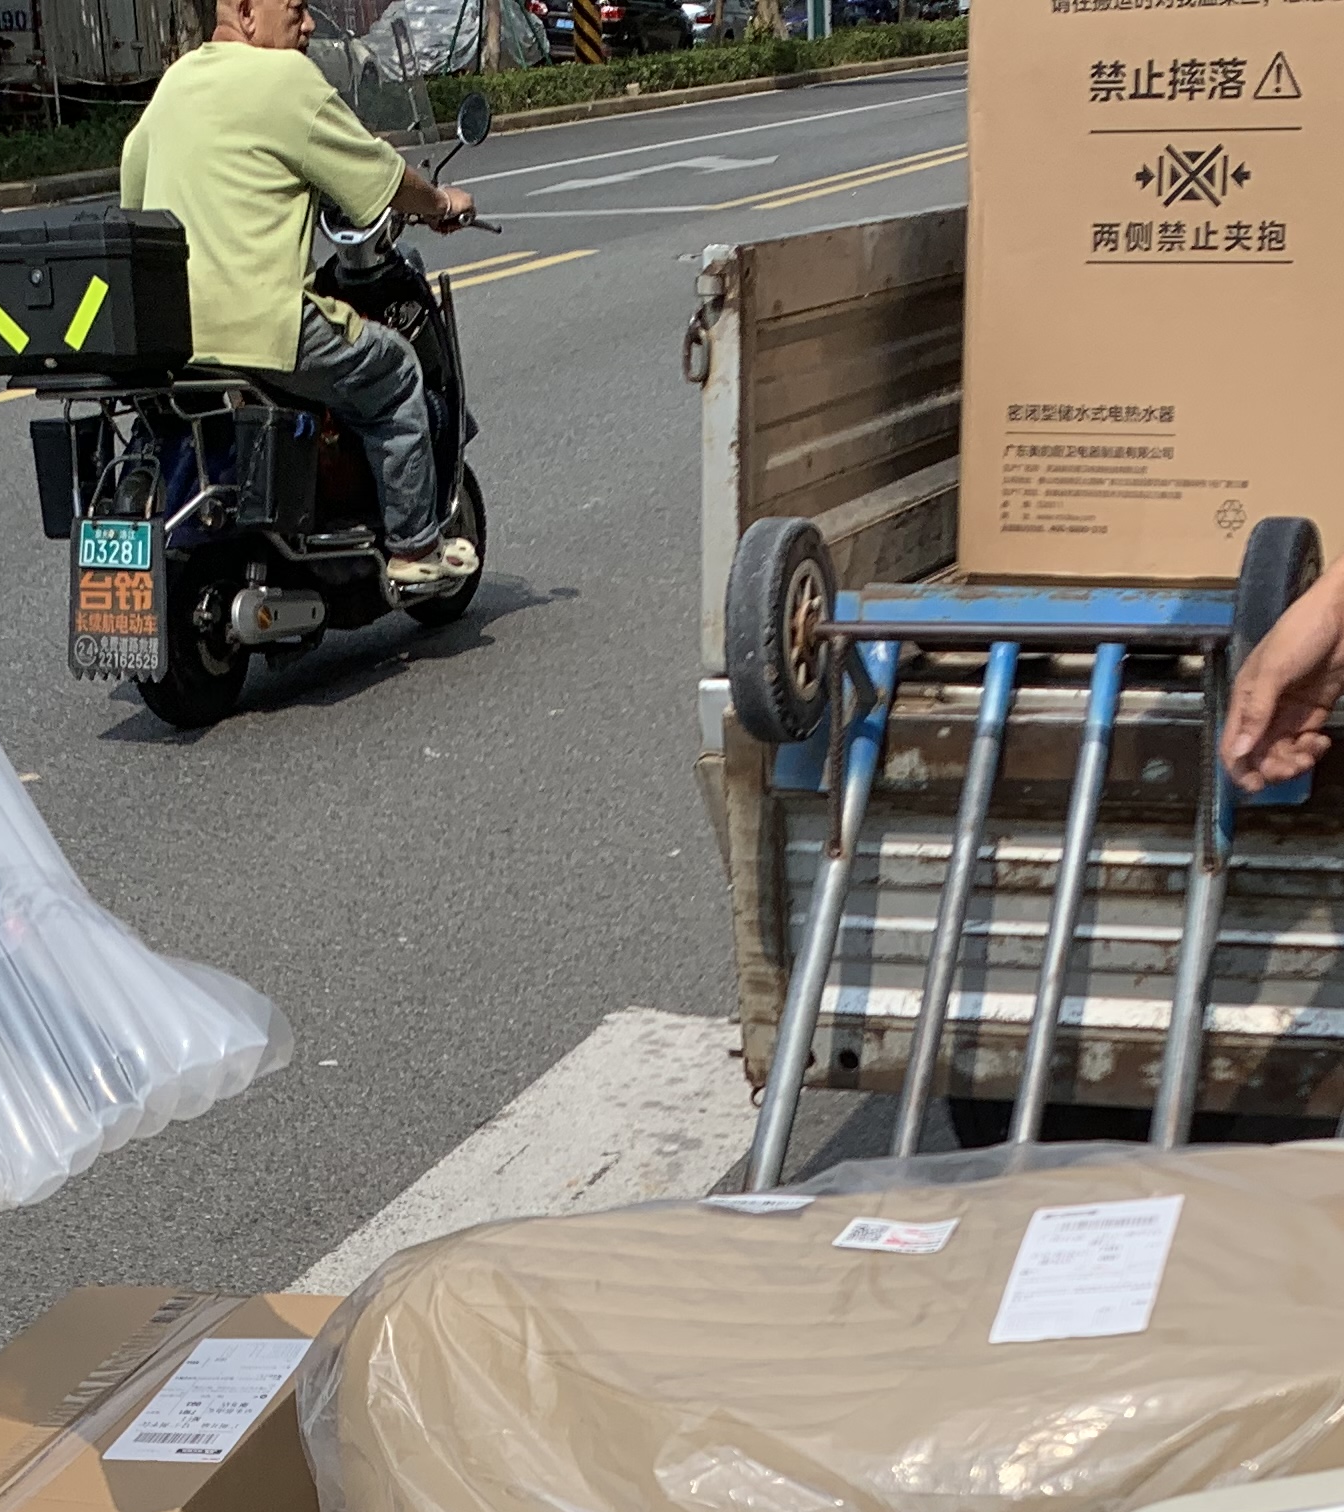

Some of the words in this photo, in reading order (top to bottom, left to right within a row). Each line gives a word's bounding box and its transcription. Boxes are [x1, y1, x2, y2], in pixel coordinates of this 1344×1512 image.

[1089, 56, 1247, 102] 禁止摔落
[1092, 221, 1286, 252] 两侧禁止夹抱
[1008, 404, 1175, 423] 密闭型储水式电热水器
[83, 540, 143, 564] D3281
[80, 571, 153, 610] 台铃
[99, 653, 158, 669] 22162529
